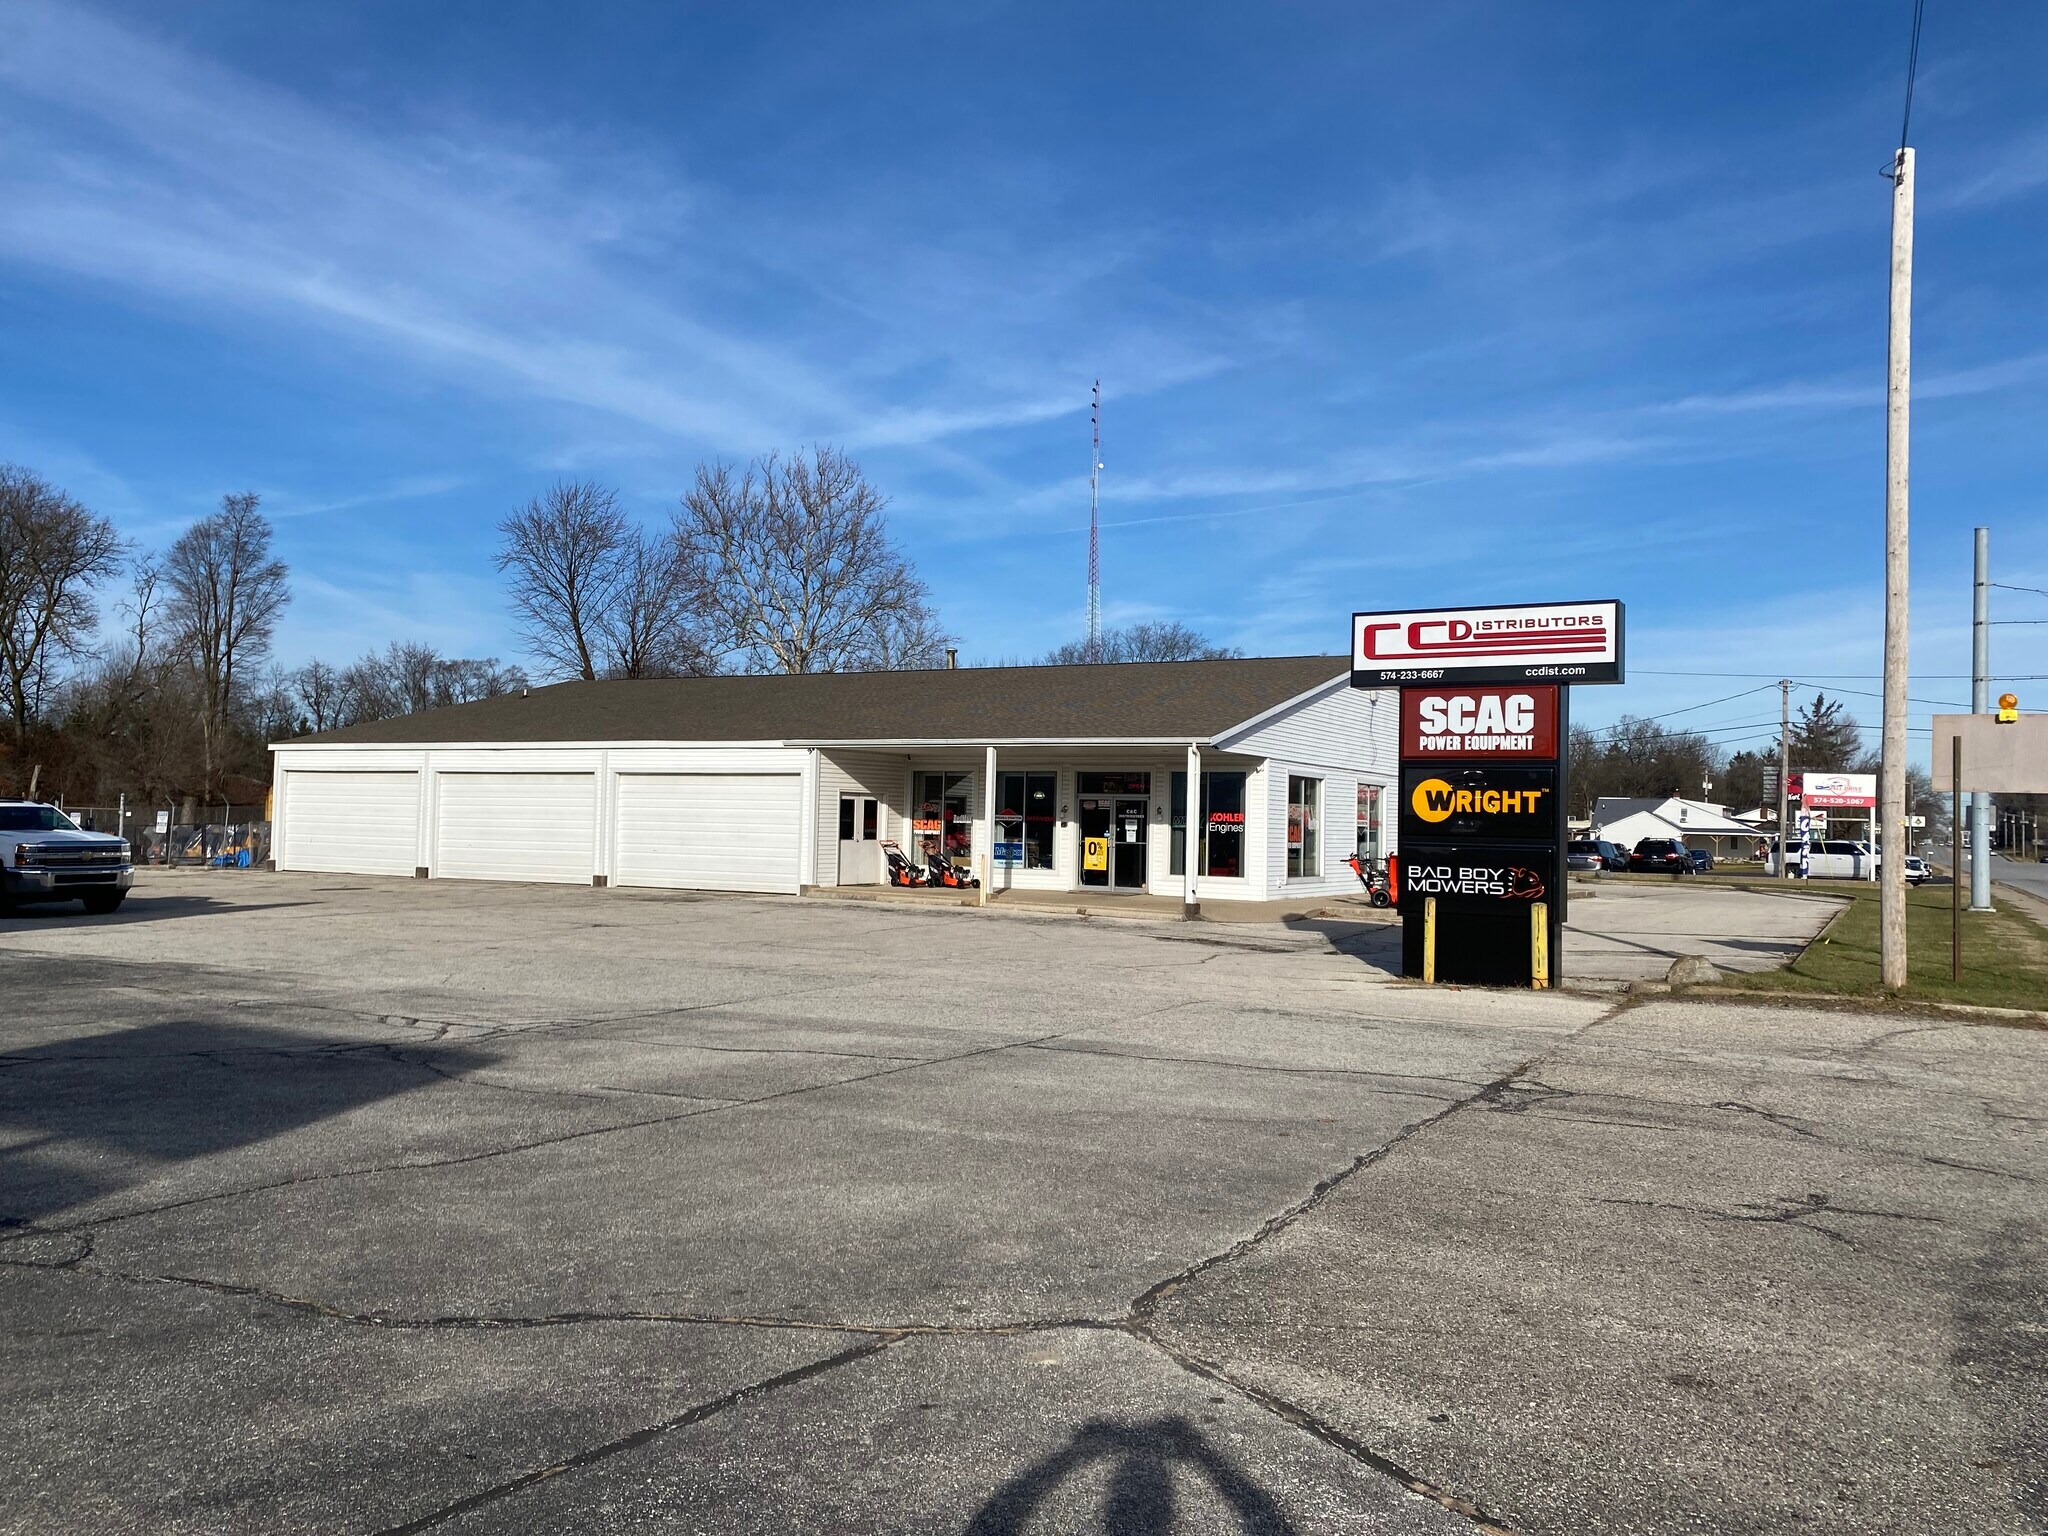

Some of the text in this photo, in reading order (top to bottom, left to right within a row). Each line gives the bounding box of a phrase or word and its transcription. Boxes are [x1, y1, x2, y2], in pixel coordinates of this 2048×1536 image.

[1380, 665, 1586, 680] 574-233-6667 ccdist.com
[1419, 694, 1535, 734] SCAG
[1419, 735, 1534, 751] POWER EQUIPMENT
[913, 819, 941, 830] SCAG
[1210, 812, 1246, 822] KOHLER
[1209, 823, 1245, 833] Engines
[1408, 865, 1504, 880] BAD BOY
[1408, 879, 1504, 895] MOWERS
